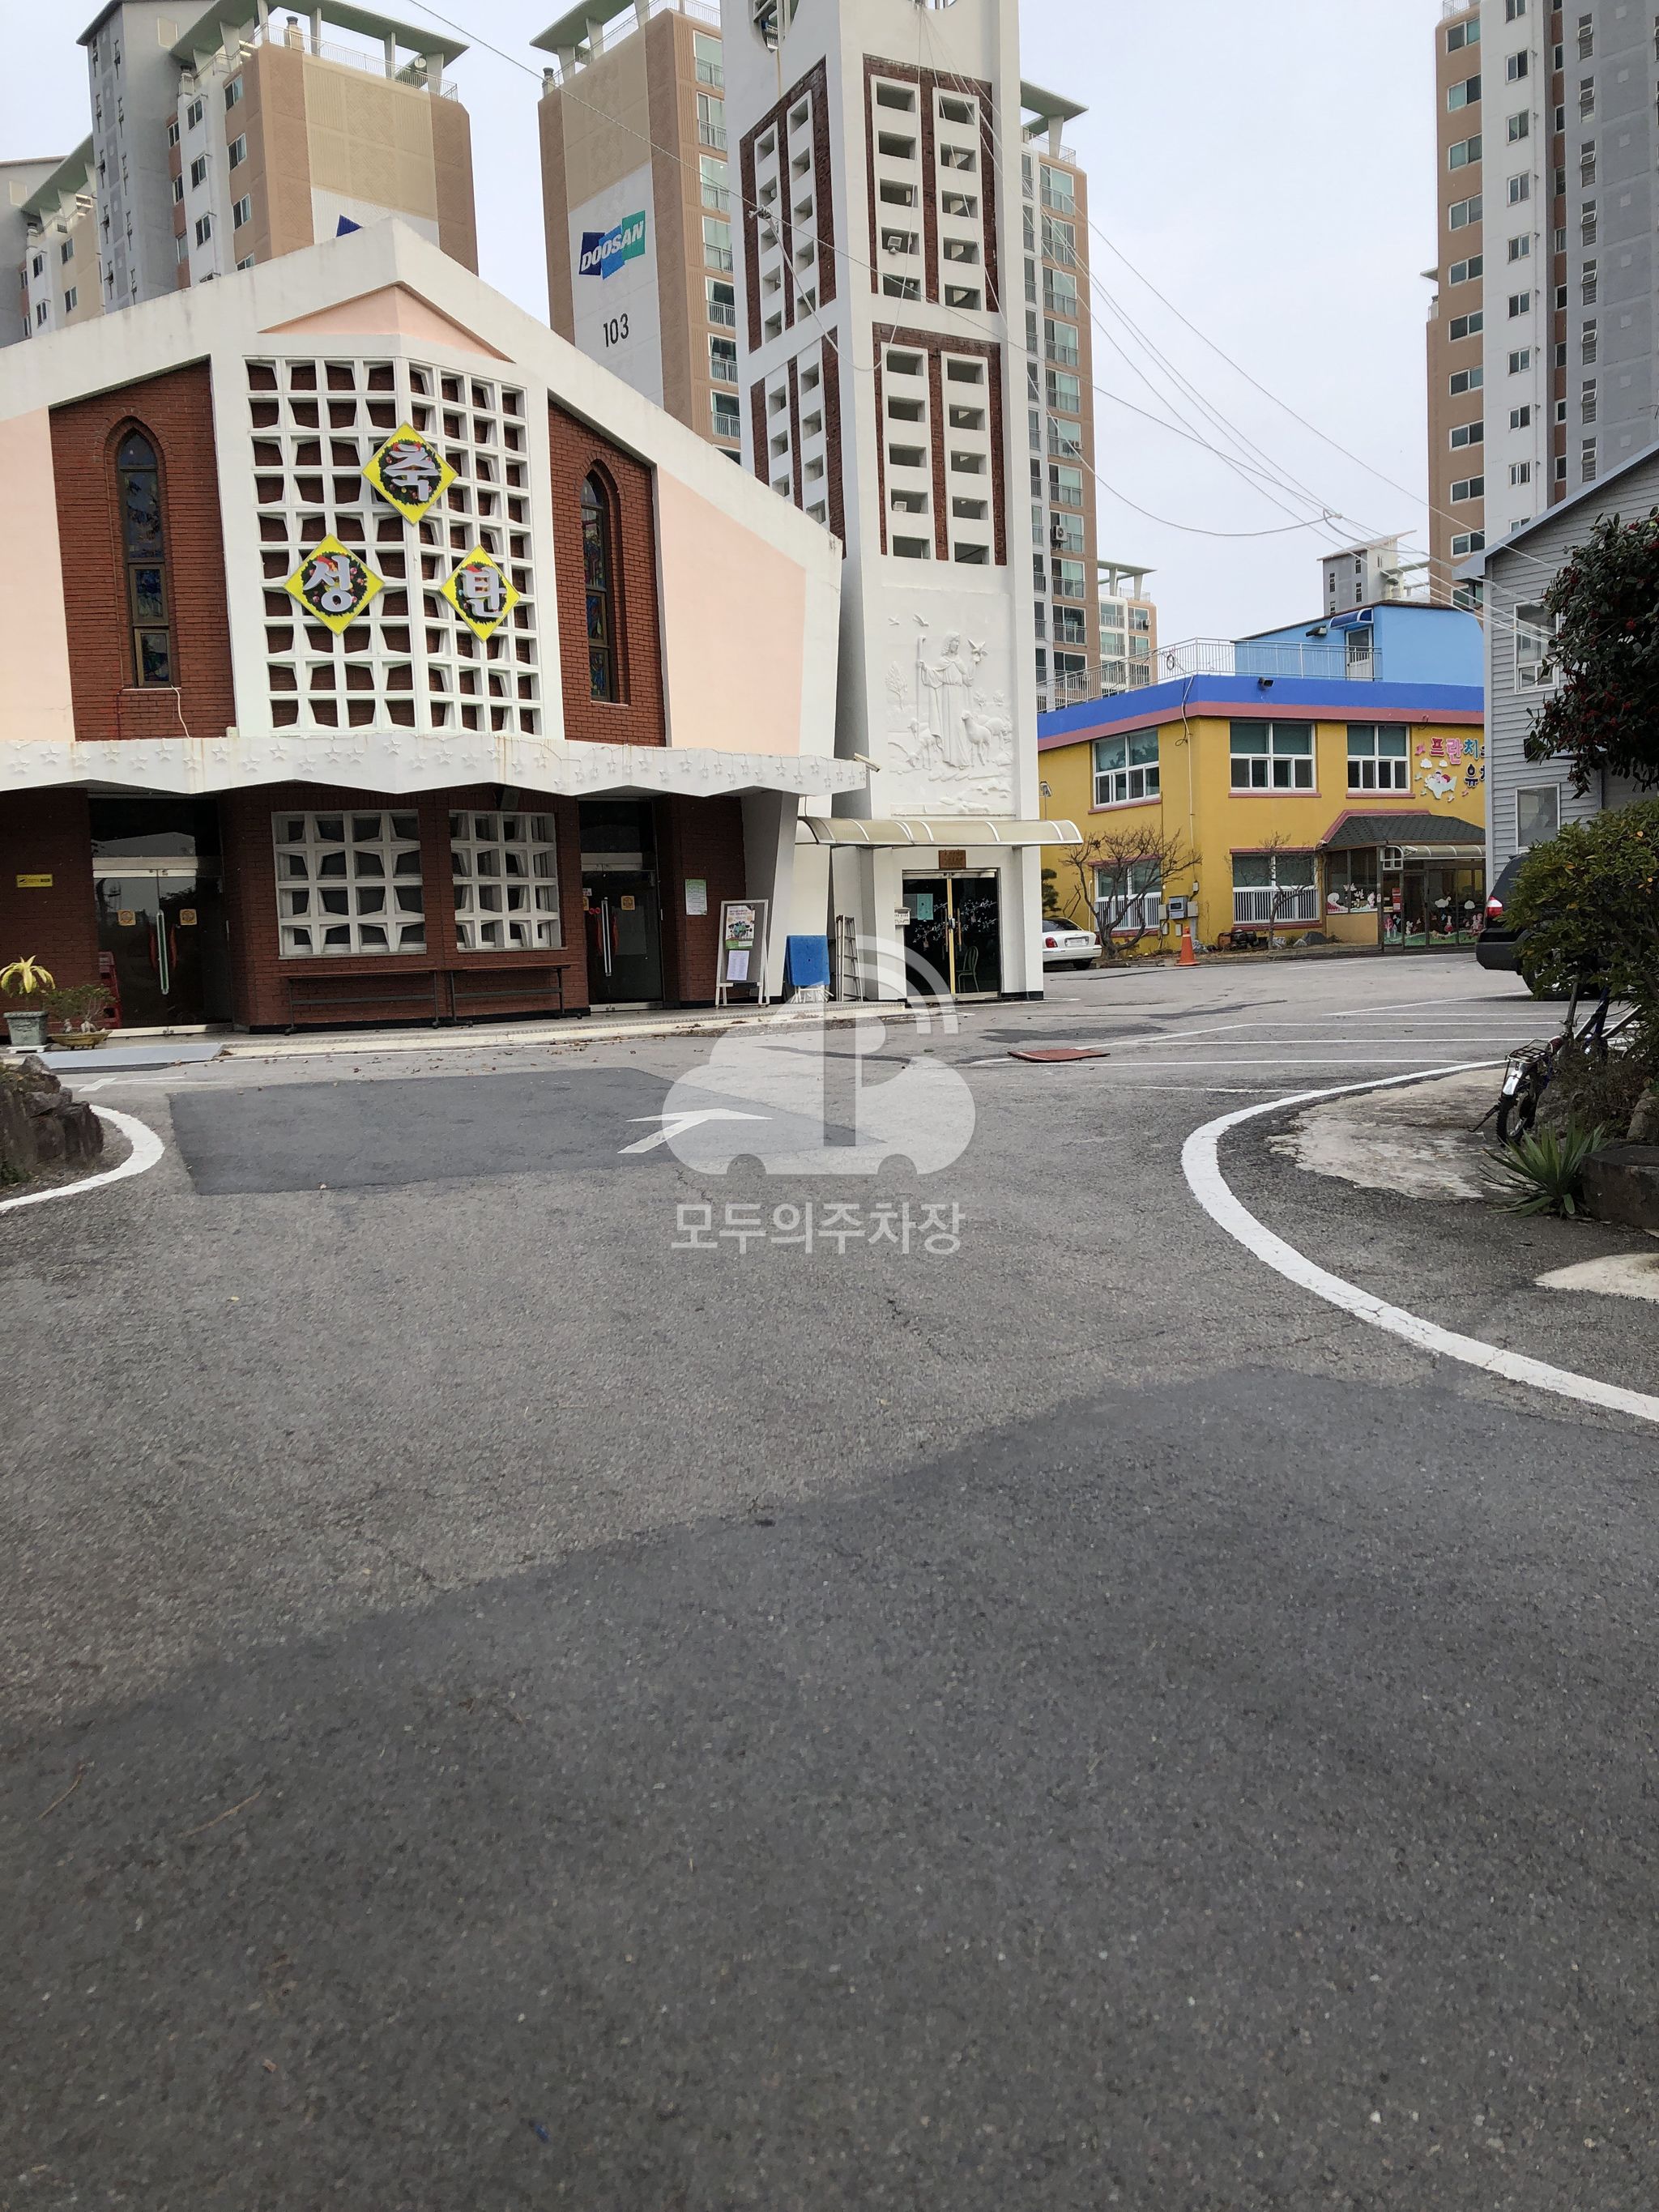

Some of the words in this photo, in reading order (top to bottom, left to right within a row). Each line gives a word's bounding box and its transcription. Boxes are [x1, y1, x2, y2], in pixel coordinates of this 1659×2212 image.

[581, 220, 645, 272] DOOSAN
[603, 313, 629, 347] 103
[382, 443, 441, 501] 축
[303, 555, 352, 612] 성
[461, 566, 508, 618] 탄
[1429, 736, 1486, 765] 프란치
